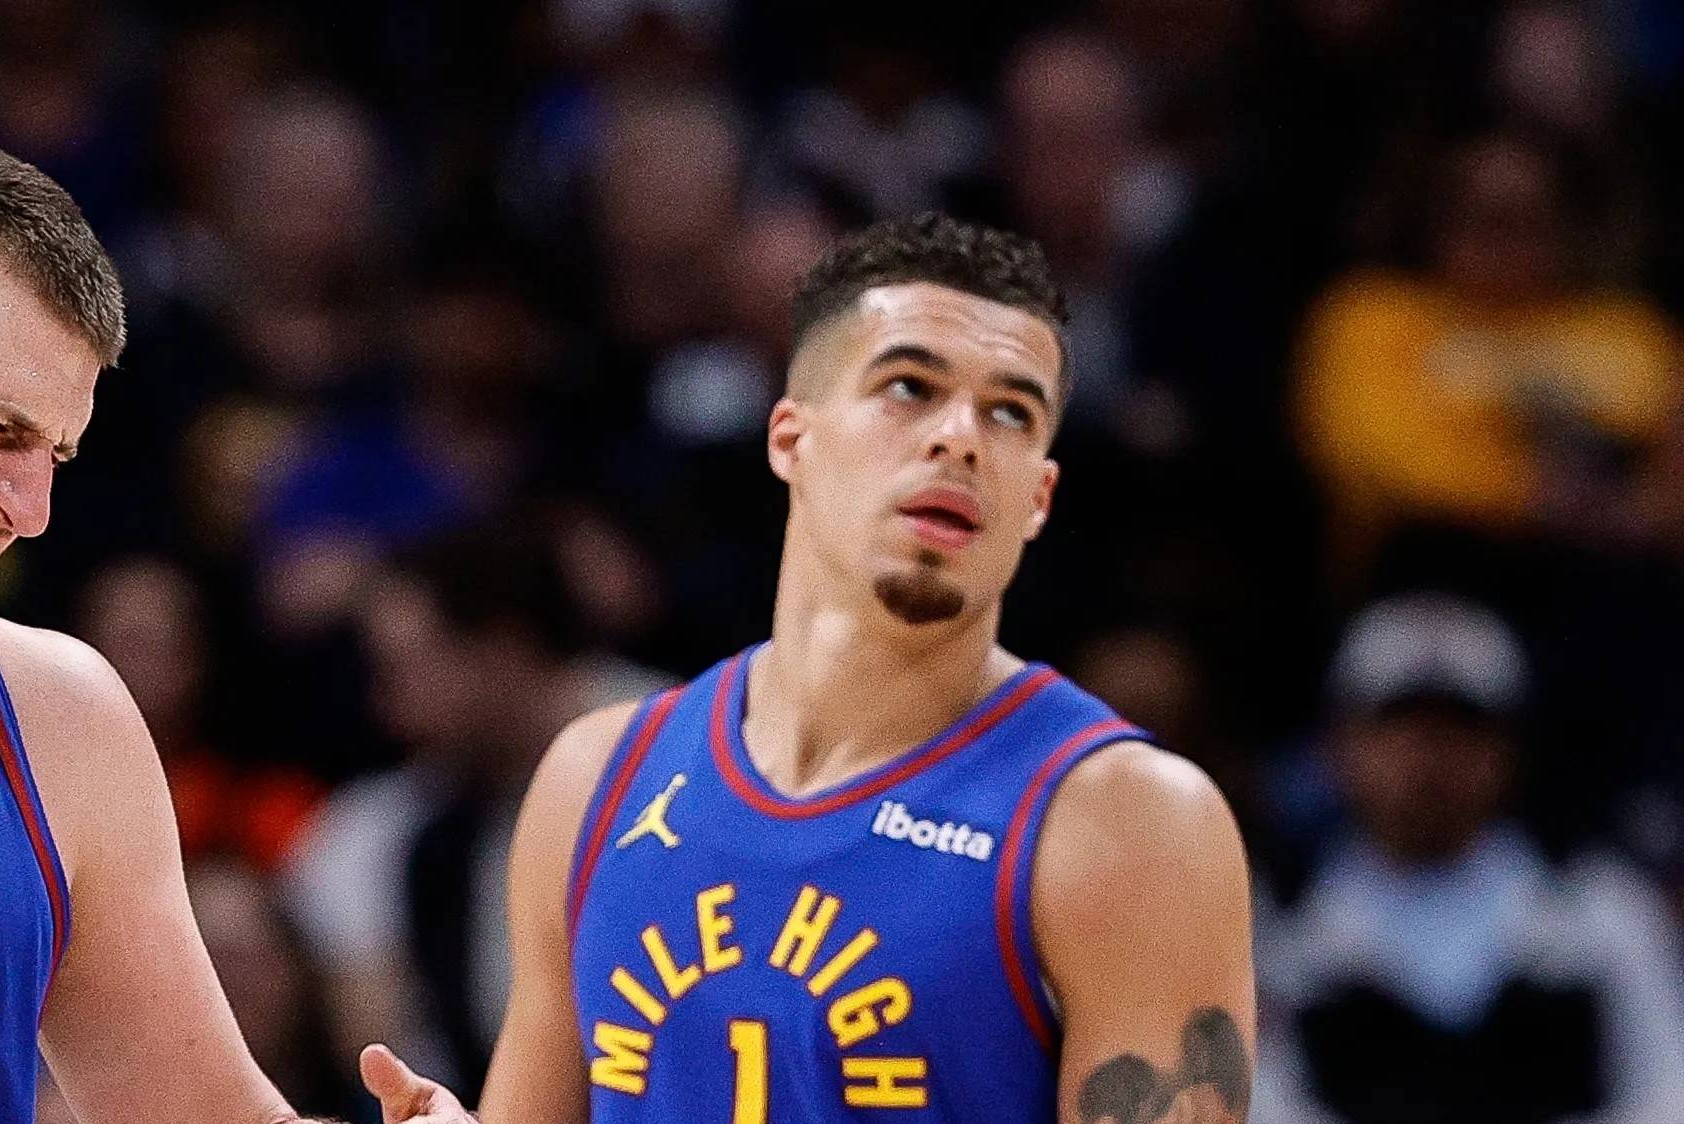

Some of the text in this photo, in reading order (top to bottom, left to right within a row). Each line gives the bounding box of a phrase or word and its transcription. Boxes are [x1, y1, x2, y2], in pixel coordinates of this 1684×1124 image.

[871, 800, 994, 861] ibotta
[588, 883, 929, 1109] MILE HIGH
